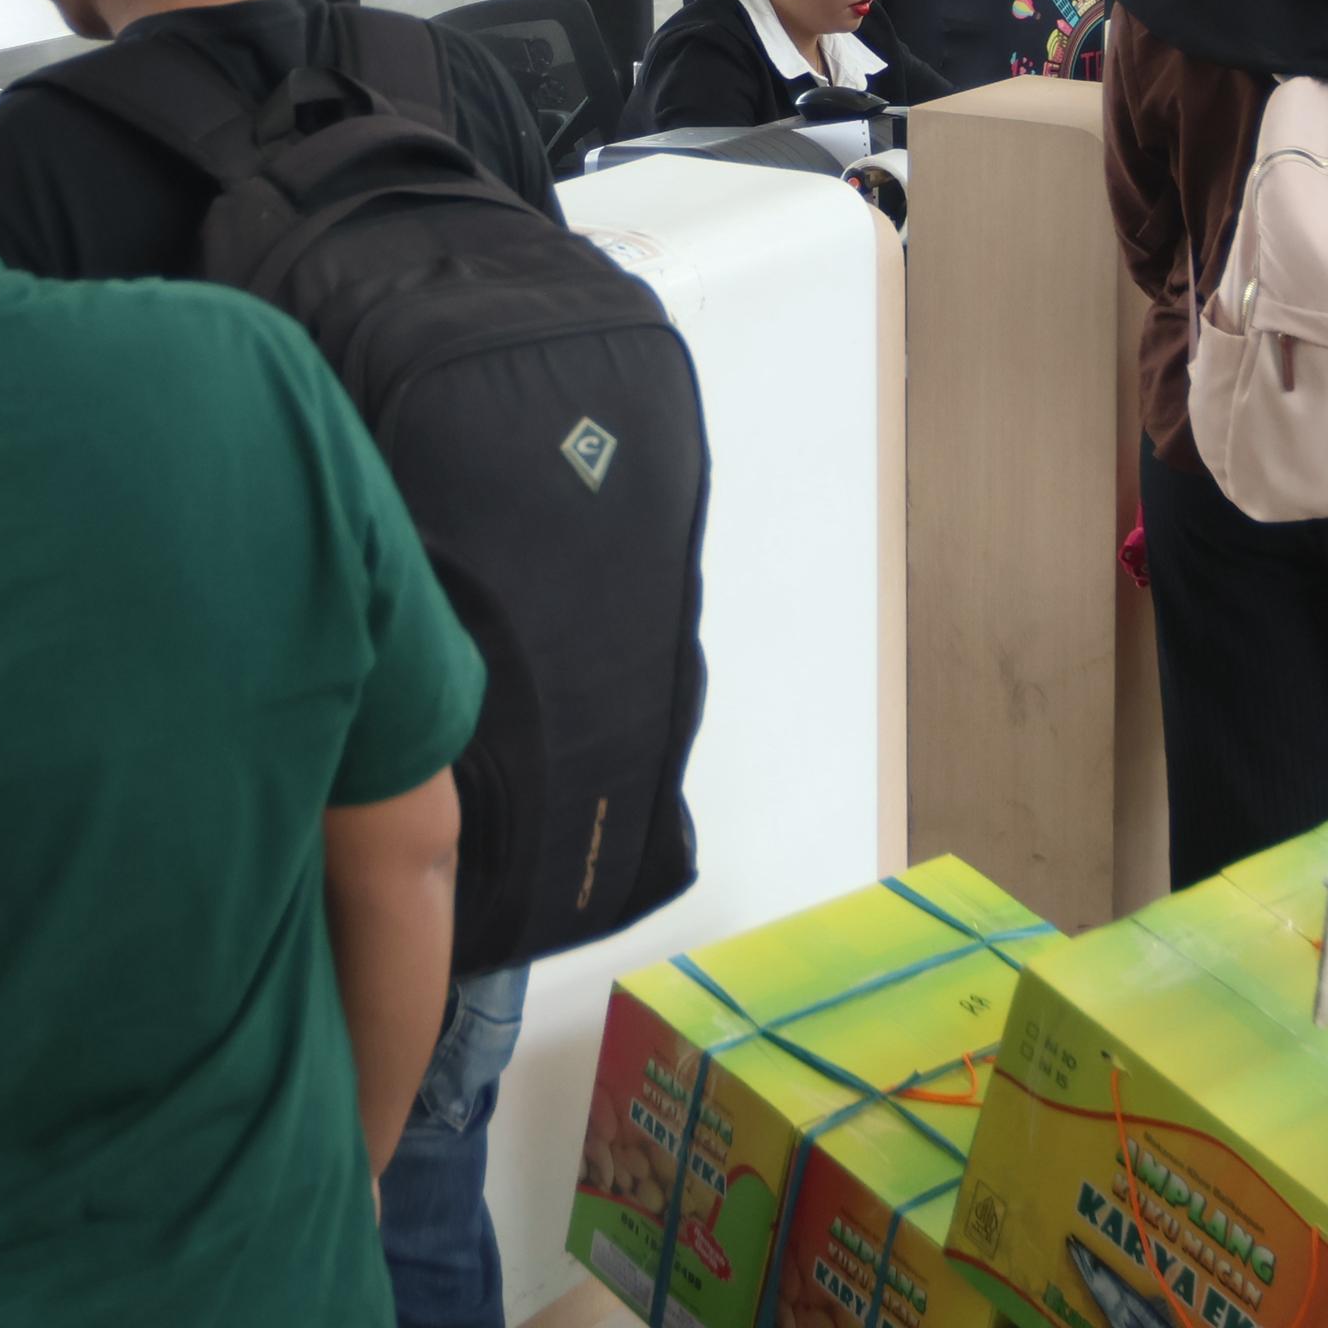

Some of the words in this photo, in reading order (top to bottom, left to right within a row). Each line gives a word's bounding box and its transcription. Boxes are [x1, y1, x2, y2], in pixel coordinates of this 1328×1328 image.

[629, 1096, 686, 1158] KARY
[688, 1150, 728, 1200] EKA
[813, 1256, 871, 1322] KARY
[1076, 1180, 1197, 1309] KARYA
[1200, 1284, 1260, 1328] EK
